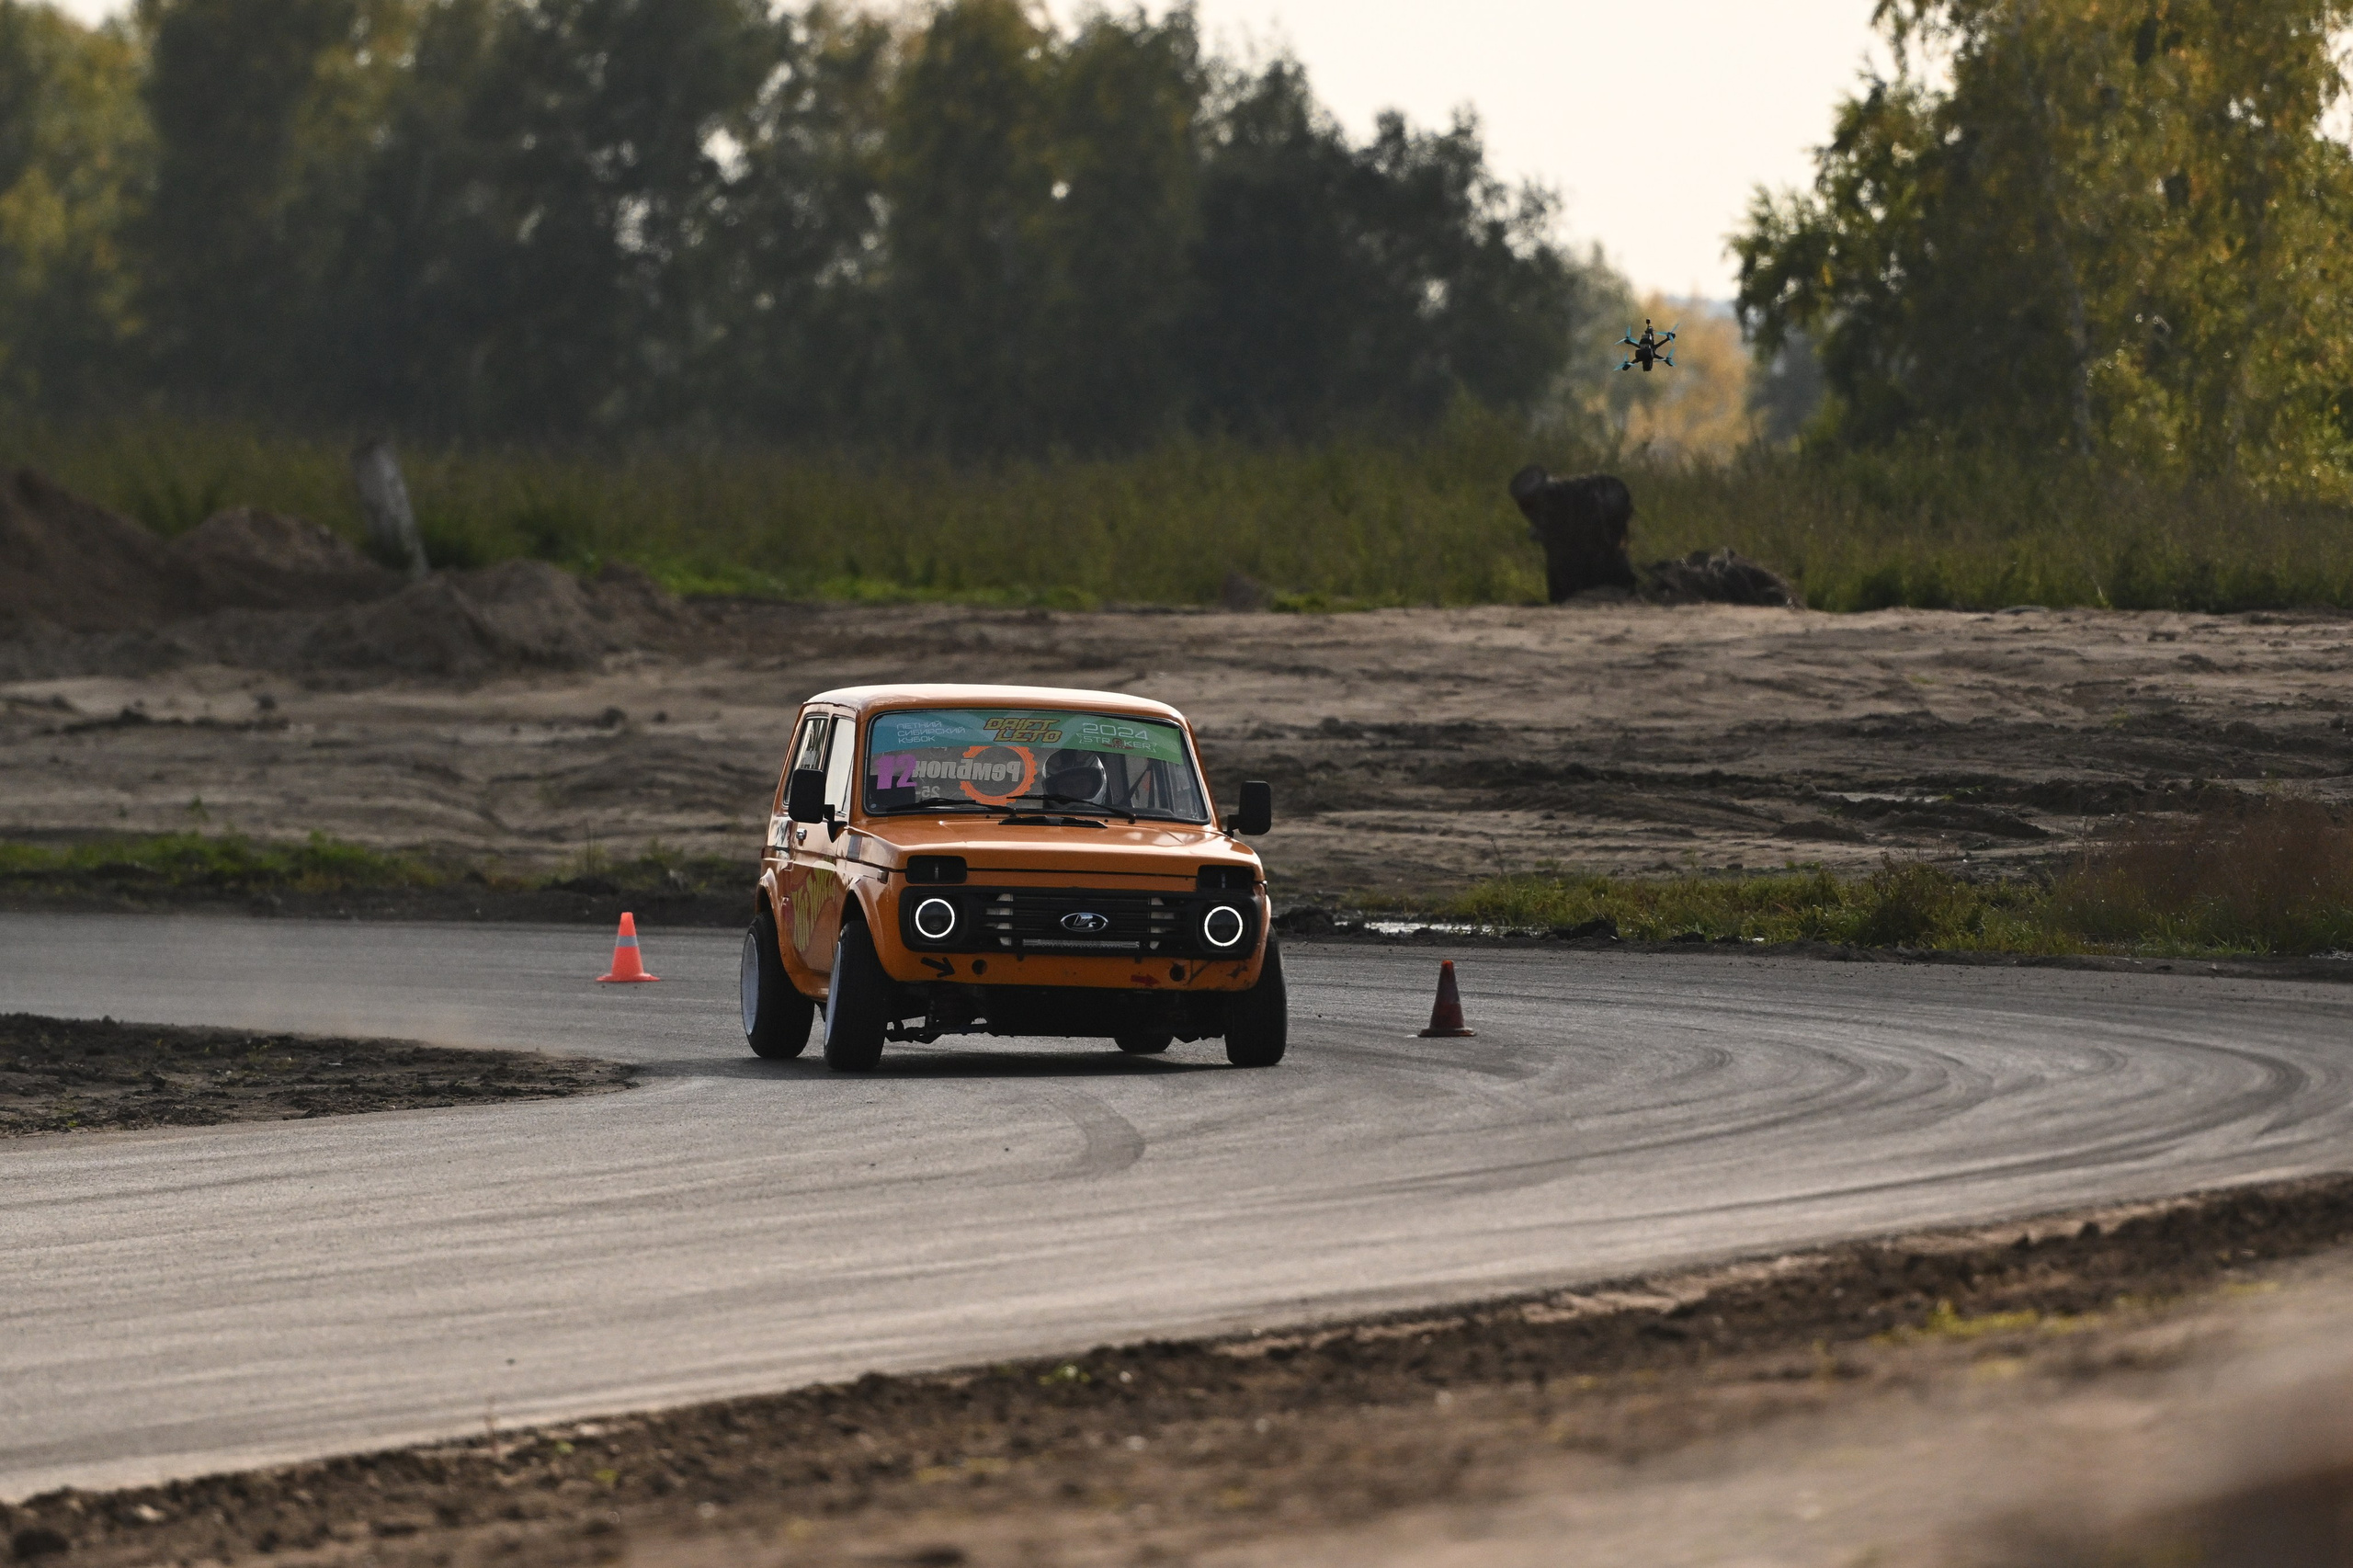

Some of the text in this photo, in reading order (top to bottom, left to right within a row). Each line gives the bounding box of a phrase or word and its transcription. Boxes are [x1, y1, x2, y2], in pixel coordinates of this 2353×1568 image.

[896, 721, 942, 730] ЛЕТНИЙ
[983, 718, 1060, 731] DRIFT
[897, 726, 966, 737] СИБИРСКИЙ
[994, 729, 1063, 743] LETO
[1082, 722, 1149, 741] 2024
[898, 735, 936, 744] КУБОК
[874, 754, 917, 790] 12
